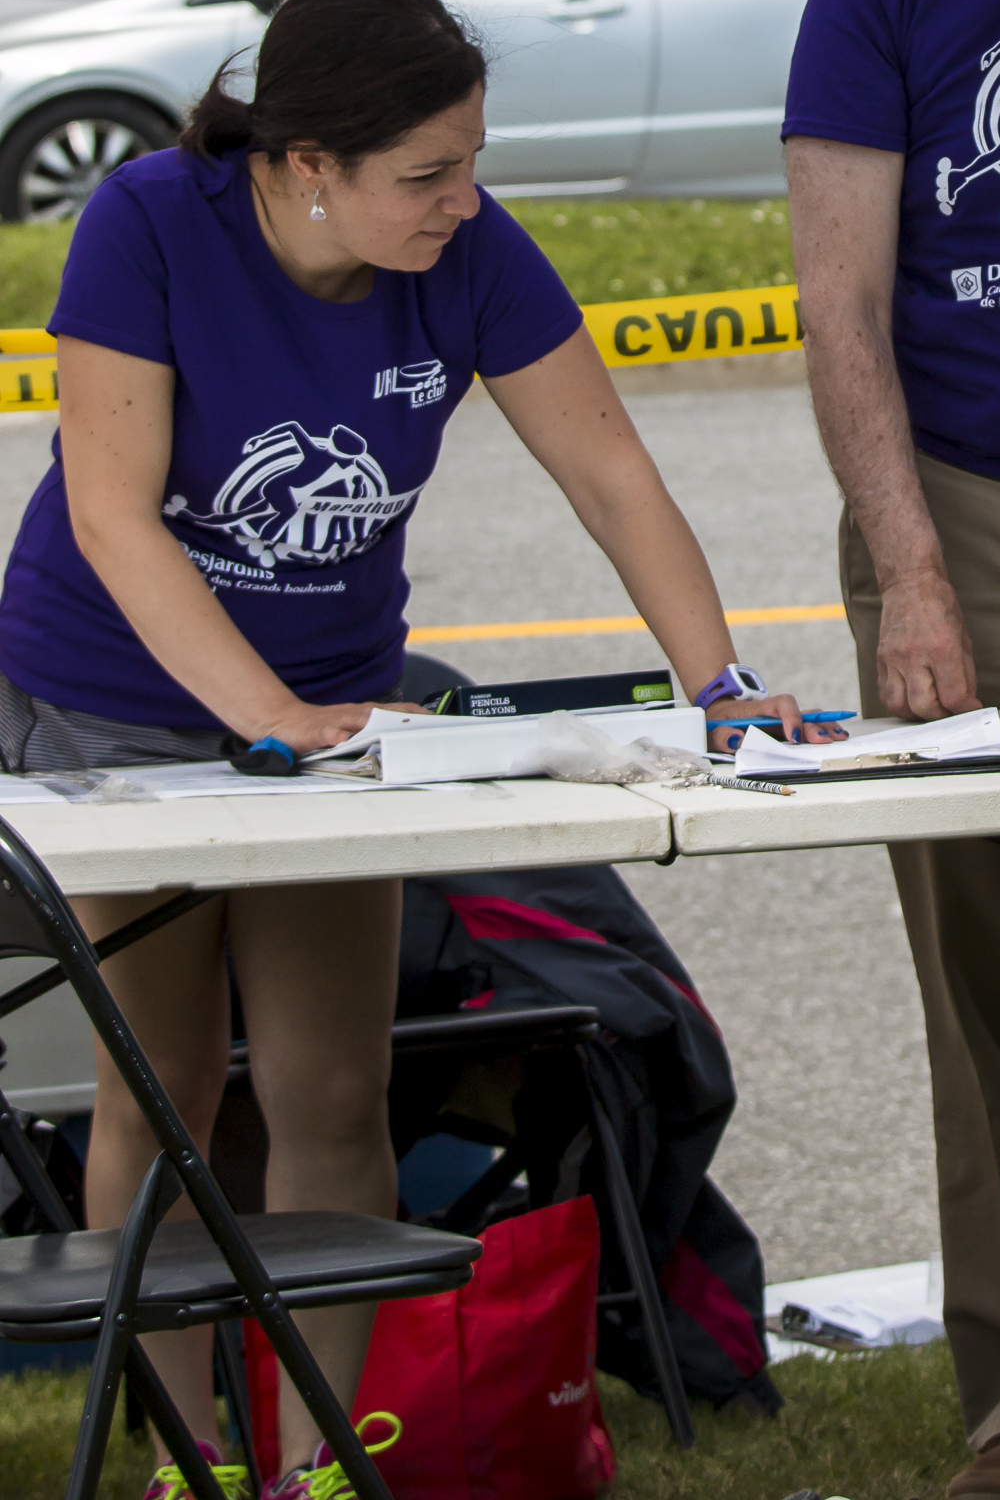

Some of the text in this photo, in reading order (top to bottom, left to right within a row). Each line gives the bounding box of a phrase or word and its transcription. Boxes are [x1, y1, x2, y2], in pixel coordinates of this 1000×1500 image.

[980, 295, 996, 308] de
[310, 499, 406, 514] Marathon
[210, 574, 347, 594] des Grands boulevards
[470, 697, 511, 708] PENCILS
[471, 705, 517, 717] CRAYONS
